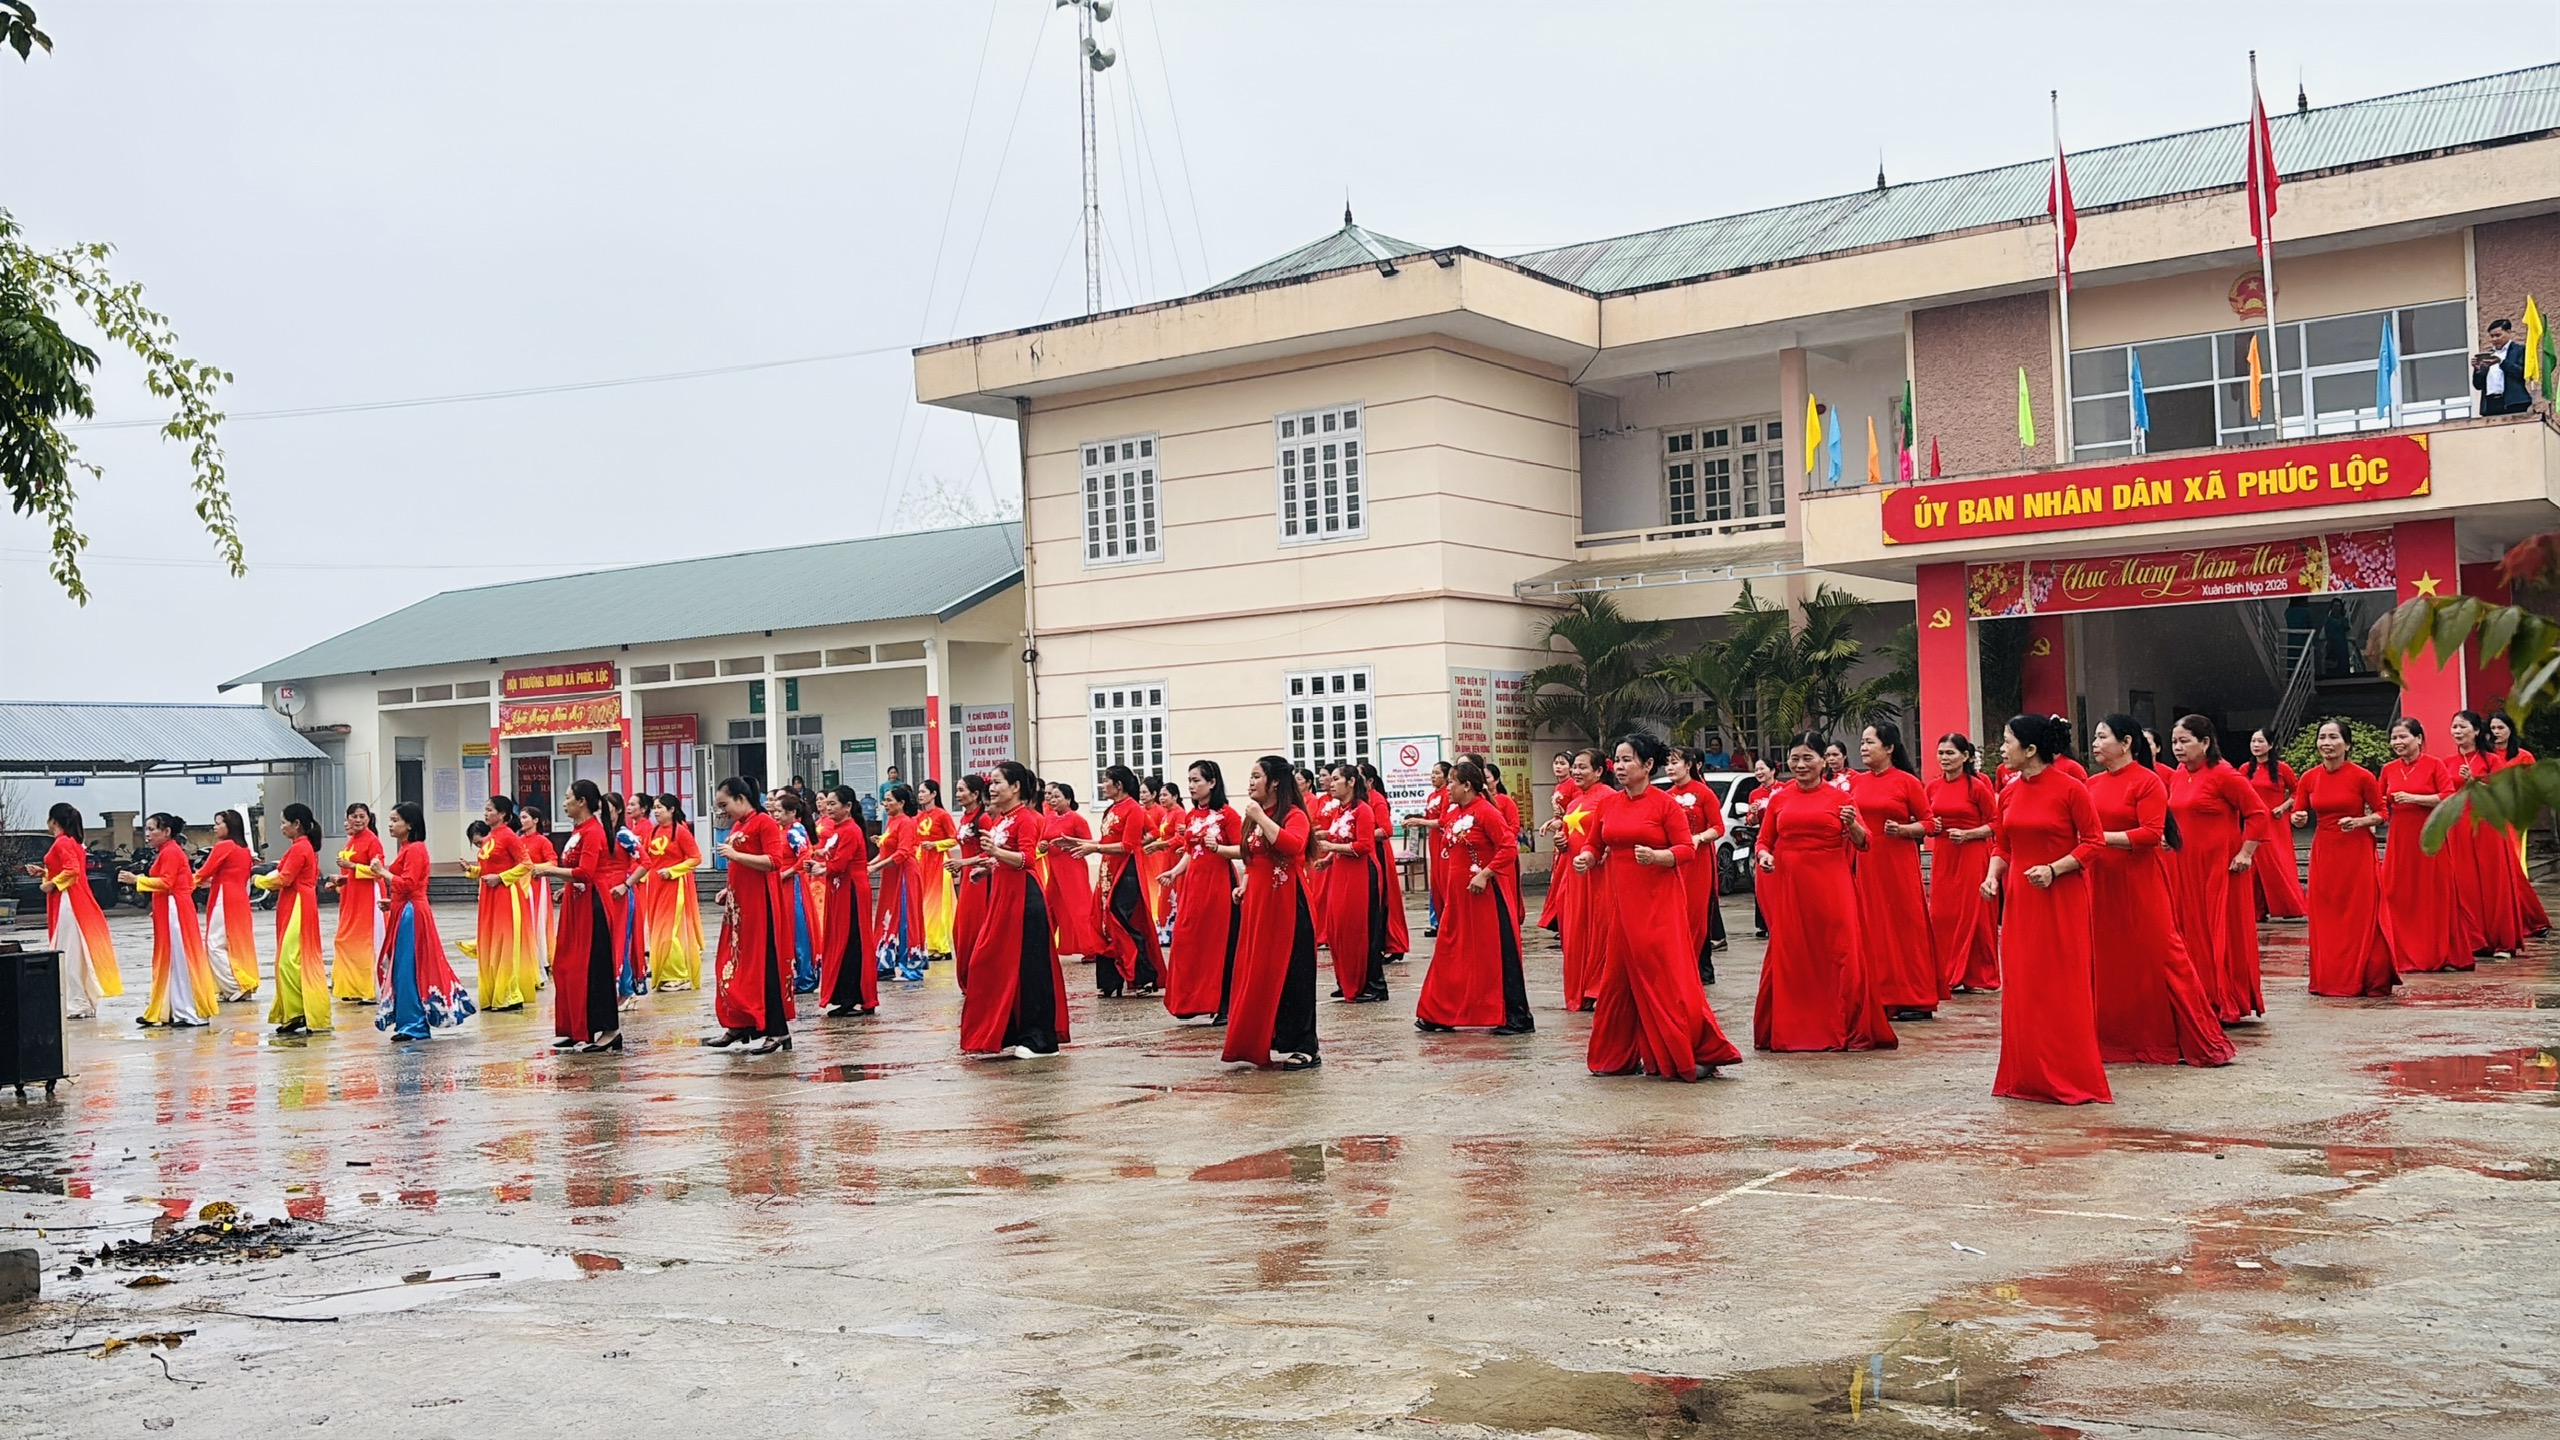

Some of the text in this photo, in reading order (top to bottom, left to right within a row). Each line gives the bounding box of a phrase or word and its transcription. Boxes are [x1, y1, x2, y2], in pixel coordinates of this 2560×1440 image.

[1914, 453, 2389, 529] ỦY BAN NHÂN DÂN XÃ PHÚC LỘC
[2265, 578, 2288, 592] 2026
[546, 674, 564, 687] UBND
[576, 669, 594, 685] PHÚC
[596, 668, 609, 685] LỘC
[1386, 788, 1425, 799] KHÔNG
